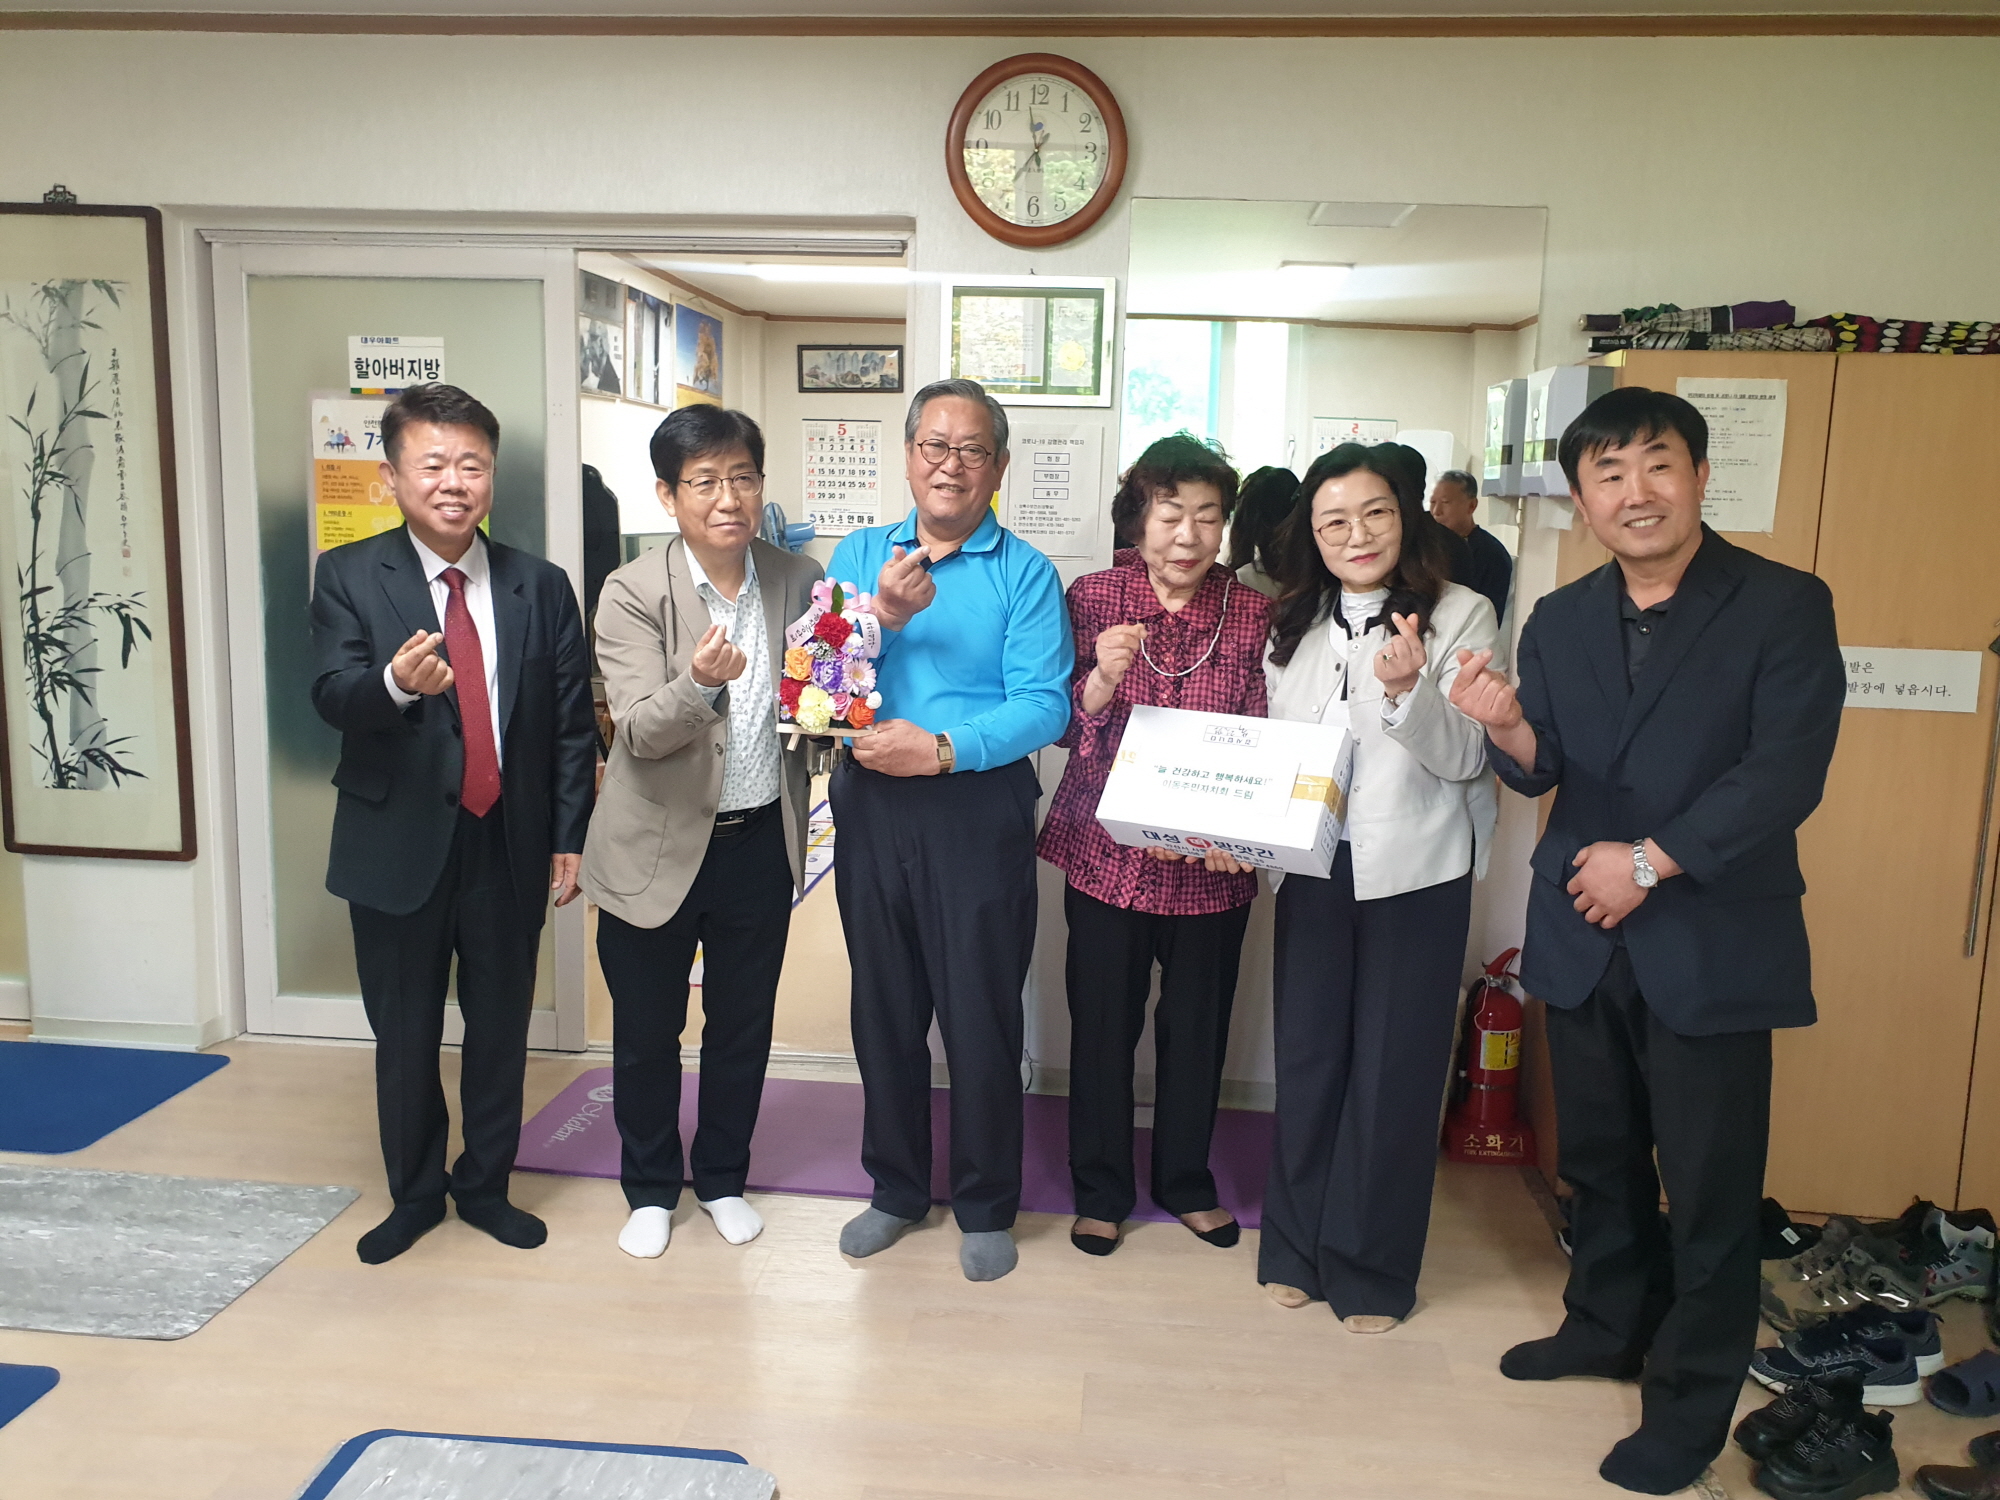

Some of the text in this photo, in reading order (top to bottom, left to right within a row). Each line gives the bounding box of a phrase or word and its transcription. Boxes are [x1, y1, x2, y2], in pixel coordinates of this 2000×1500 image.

[1004, 91, 1020, 111] 11
[1030, 84, 1050, 105] 12
[1061, 92, 1069, 112] 1
[984, 110, 1002, 130] 10
[1079, 113, 1092, 133] 2
[1084, 142, 1097, 162] 3
[1074, 171, 1086, 190] 4
[1027, 196, 1040, 217] 6
[1054, 191, 1067, 211] 5
[354, 358, 440, 380] 할아버지방
[838, 424, 846, 435] 5
[847, 515, 874, 524] 안마원
[1843, 660, 1874, 674] 발은
[1895, 684, 1952, 698] 넣읍시다.
[1172, 767, 1210, 778] 건강하고
[1233, 789, 1254, 800] 드림
[1142, 830, 1181, 843] 대성
[1213, 840, 1276, 859] 방앗간
[1464, 1133, 1523, 1151] 소화기
